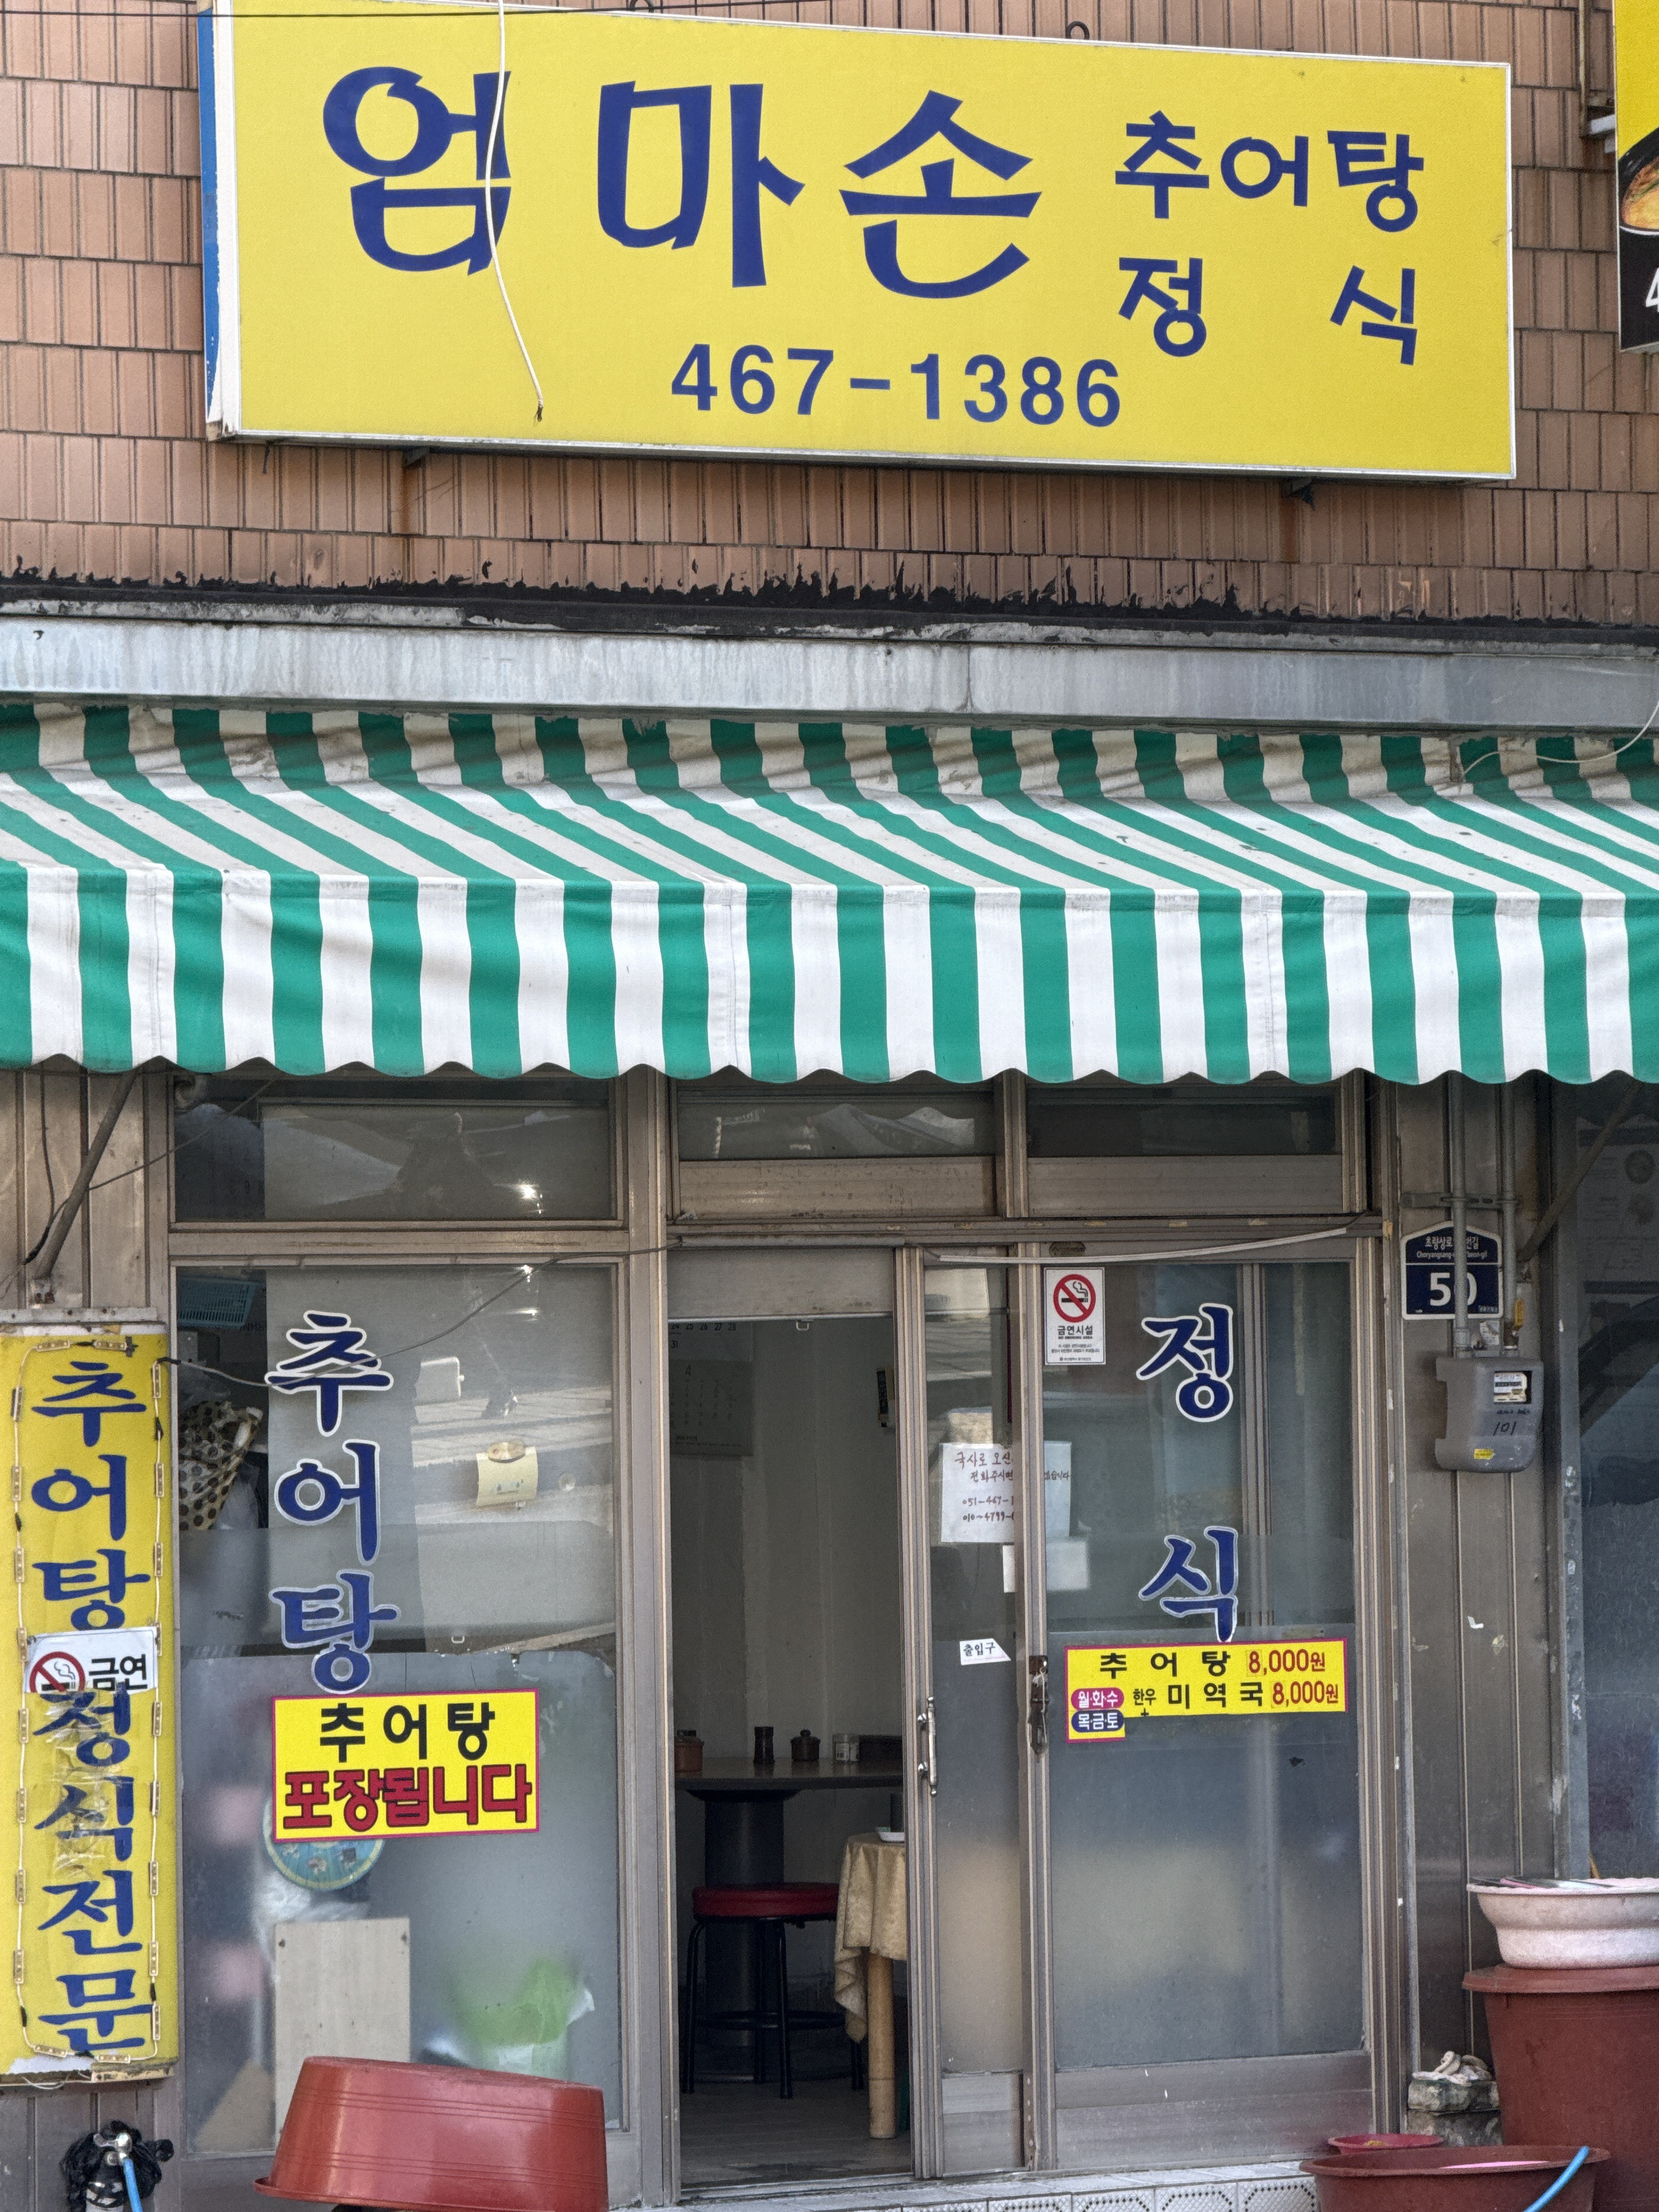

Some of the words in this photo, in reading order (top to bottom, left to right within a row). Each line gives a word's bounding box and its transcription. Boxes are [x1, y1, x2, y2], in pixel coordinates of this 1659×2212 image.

[323, 66, 1042, 300] 엄마손
[1115, 110, 1425, 233] 추어탕
[671, 344, 1121, 427] 467-1386
[1058, 1325, 1093, 1335] 금연시설
[1492, 1421, 1517, 1436] 101
[31, 1361, 151, 1631] 추어탕
[264, 1310, 401, 1694] 추어탕
[89, 1653, 148, 1691] 금연
[963, 1642, 996, 1656] 출입구
[1100, 1651, 1231, 1679] 추어탕
[1249, 1649, 1326, 1675] 8,000원
[1133, 1688, 1156, 1706] 한우
[1168, 1681, 1263, 1709] 미역국
[1272, 1680, 1339, 1707] 8,000원
[320, 1702, 495, 1763] 추어탕
[283, 1764, 533, 1831] 포장됩니다
